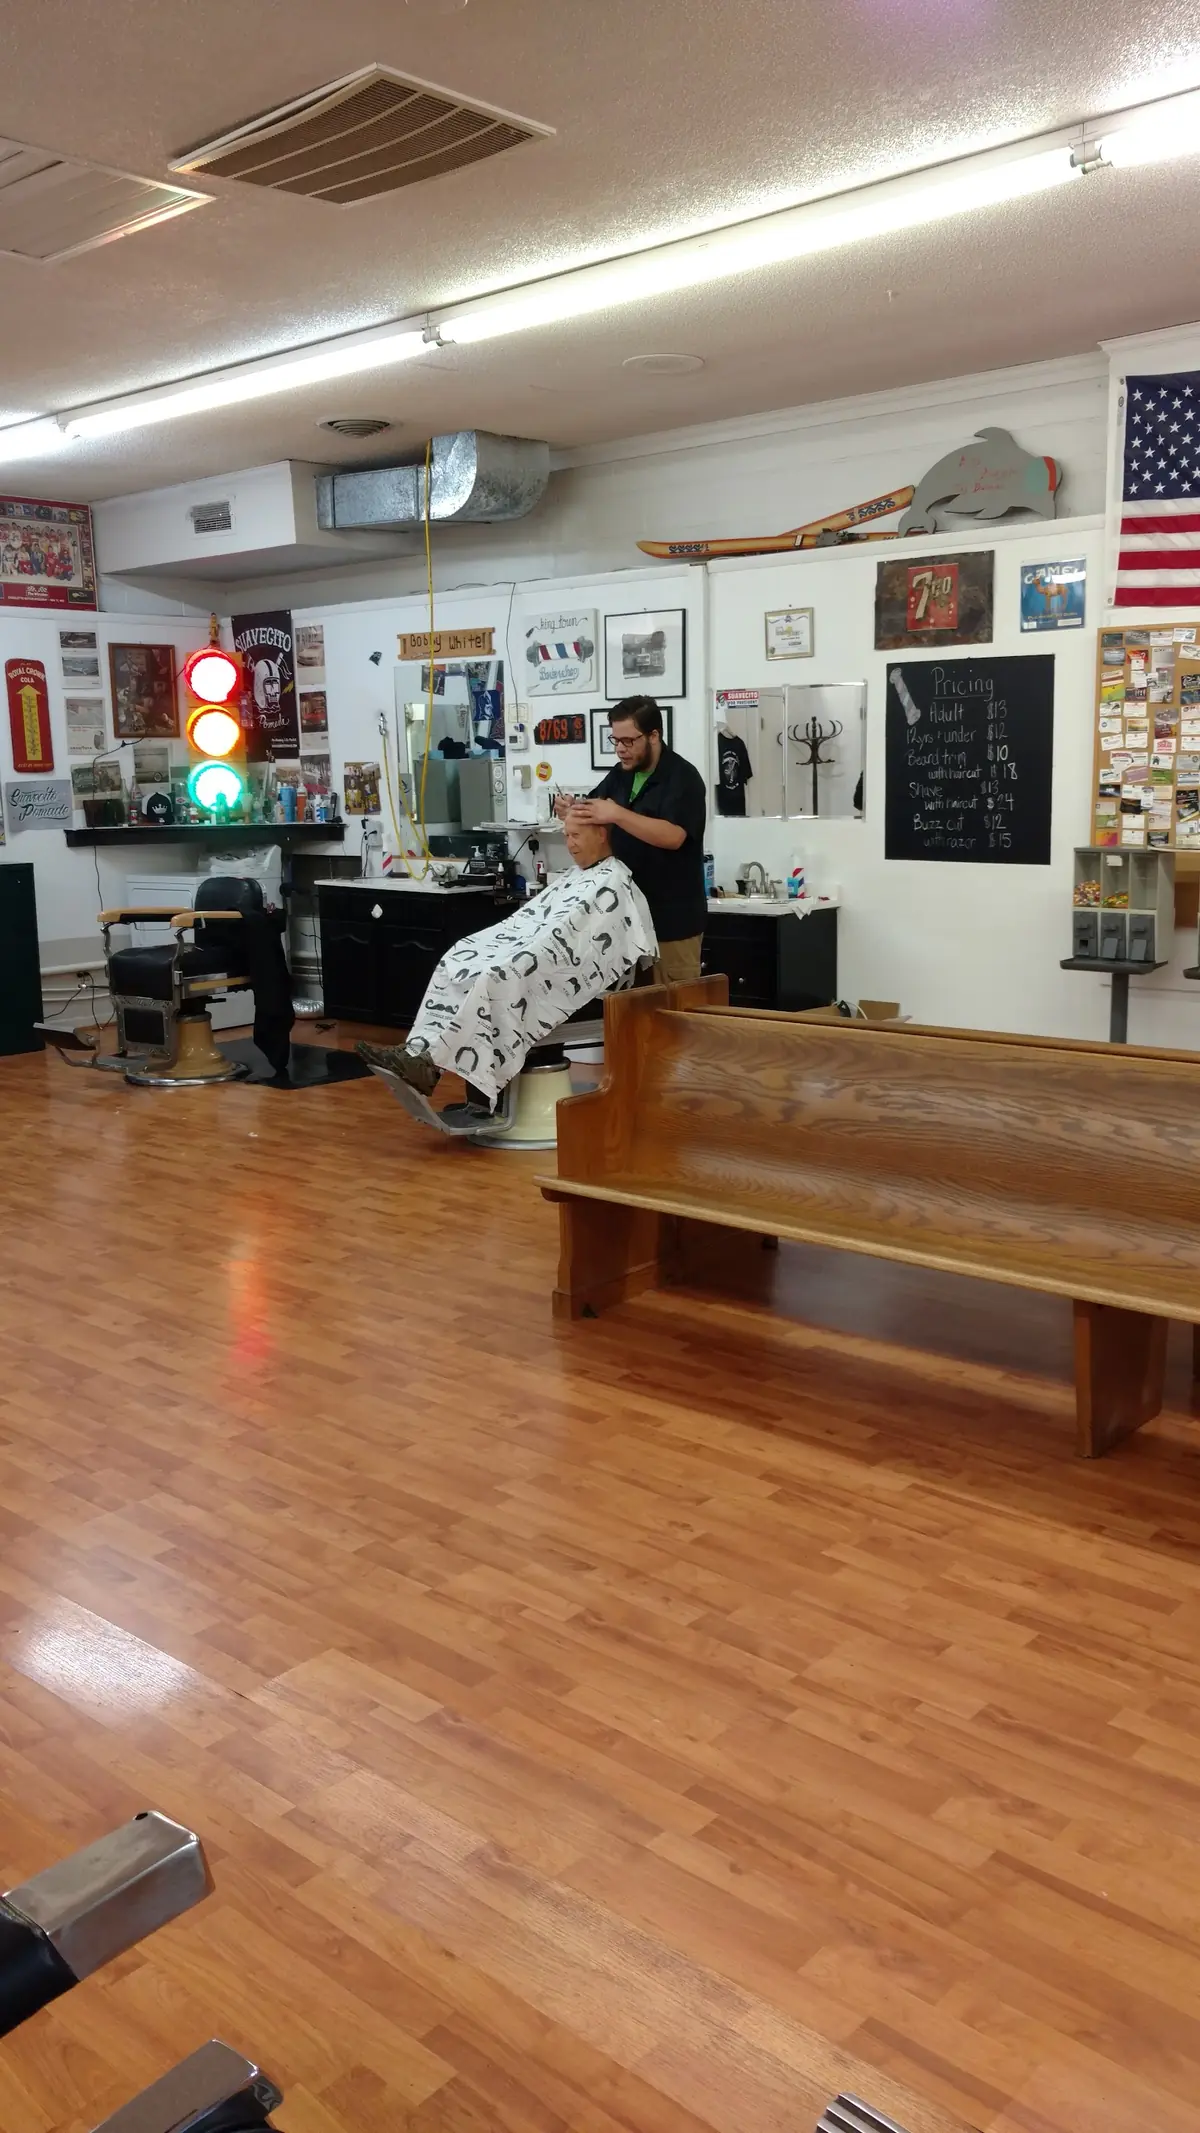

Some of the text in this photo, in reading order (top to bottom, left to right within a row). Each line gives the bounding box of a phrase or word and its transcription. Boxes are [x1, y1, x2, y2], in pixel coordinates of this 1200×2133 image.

[1024, 566, 1081, 585] CAMEL
[235, 627, 292, 653] SUAVECITO
[8, 667, 46, 681] ROYAL CROWN
[931, 666, 994, 702] Pricing
[727, 691, 758, 700] SUAVECITO
[930, 700, 1008, 723] Adult $13
[943, 725, 977, 743] under
[986, 722, 1008, 741] $12
[906, 748, 940, 767] Beard
[986, 743, 1009, 762] $10
[9, 787, 58, 807] Suavecito
[909, 780, 999, 798] Shave $13
[19, 803, 69, 821] Pomade
[913, 812, 1007, 831] Buzz cut $12
[946, 837, 977, 850] razor
[988, 832, 1012, 849] $15
